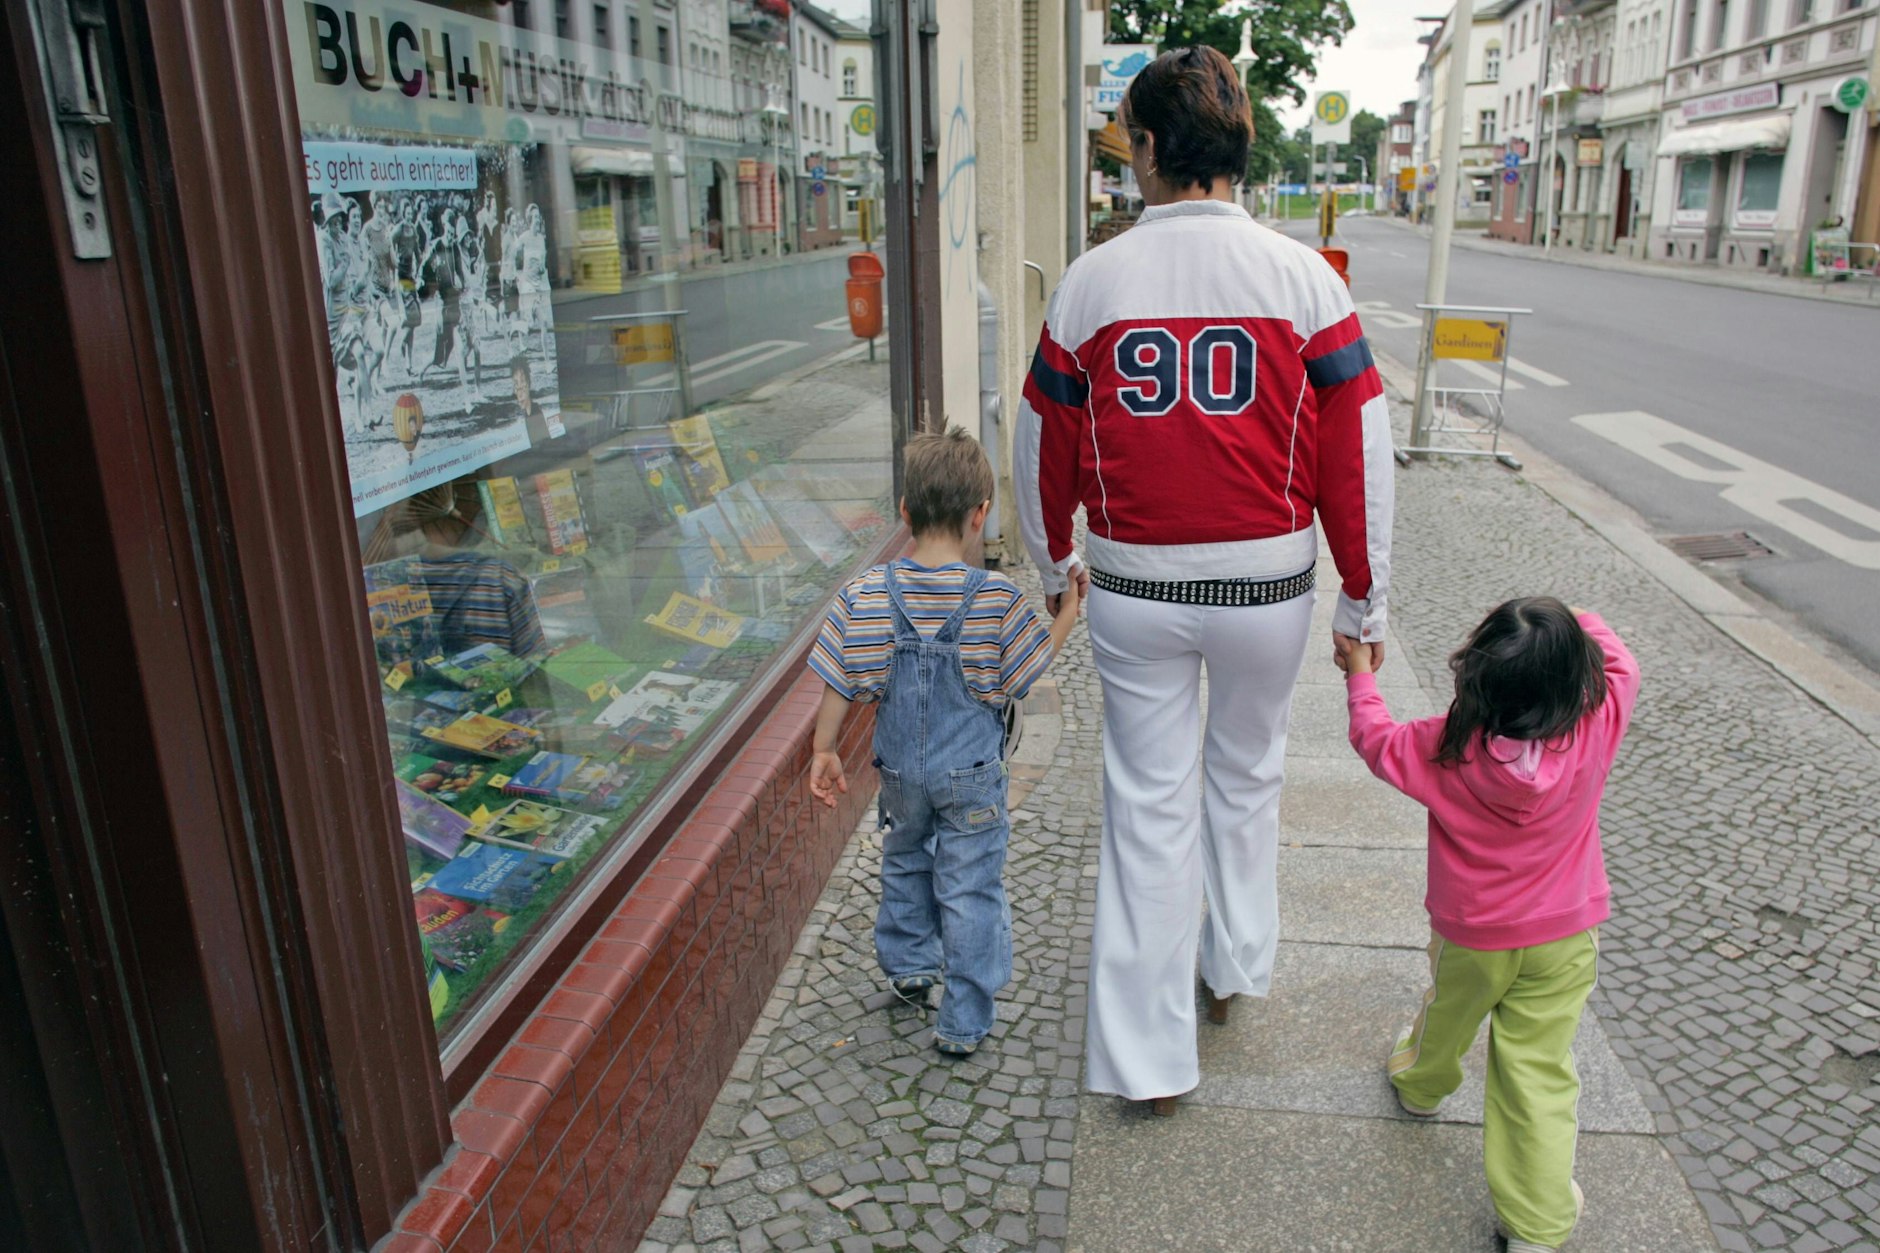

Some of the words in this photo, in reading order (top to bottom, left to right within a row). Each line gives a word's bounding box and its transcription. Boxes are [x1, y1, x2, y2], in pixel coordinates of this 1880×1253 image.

[1098, 90, 1125, 103] FIS
[1325, 100, 1339, 118] H
[327, 152, 365, 189] geht
[370, 154, 405, 183] auch
[409, 157, 474, 188] einfacher!
[1435, 332, 1493, 350] Gardinen
[1113, 324, 1258, 417] 90
[389, 597, 428, 618] Natur
